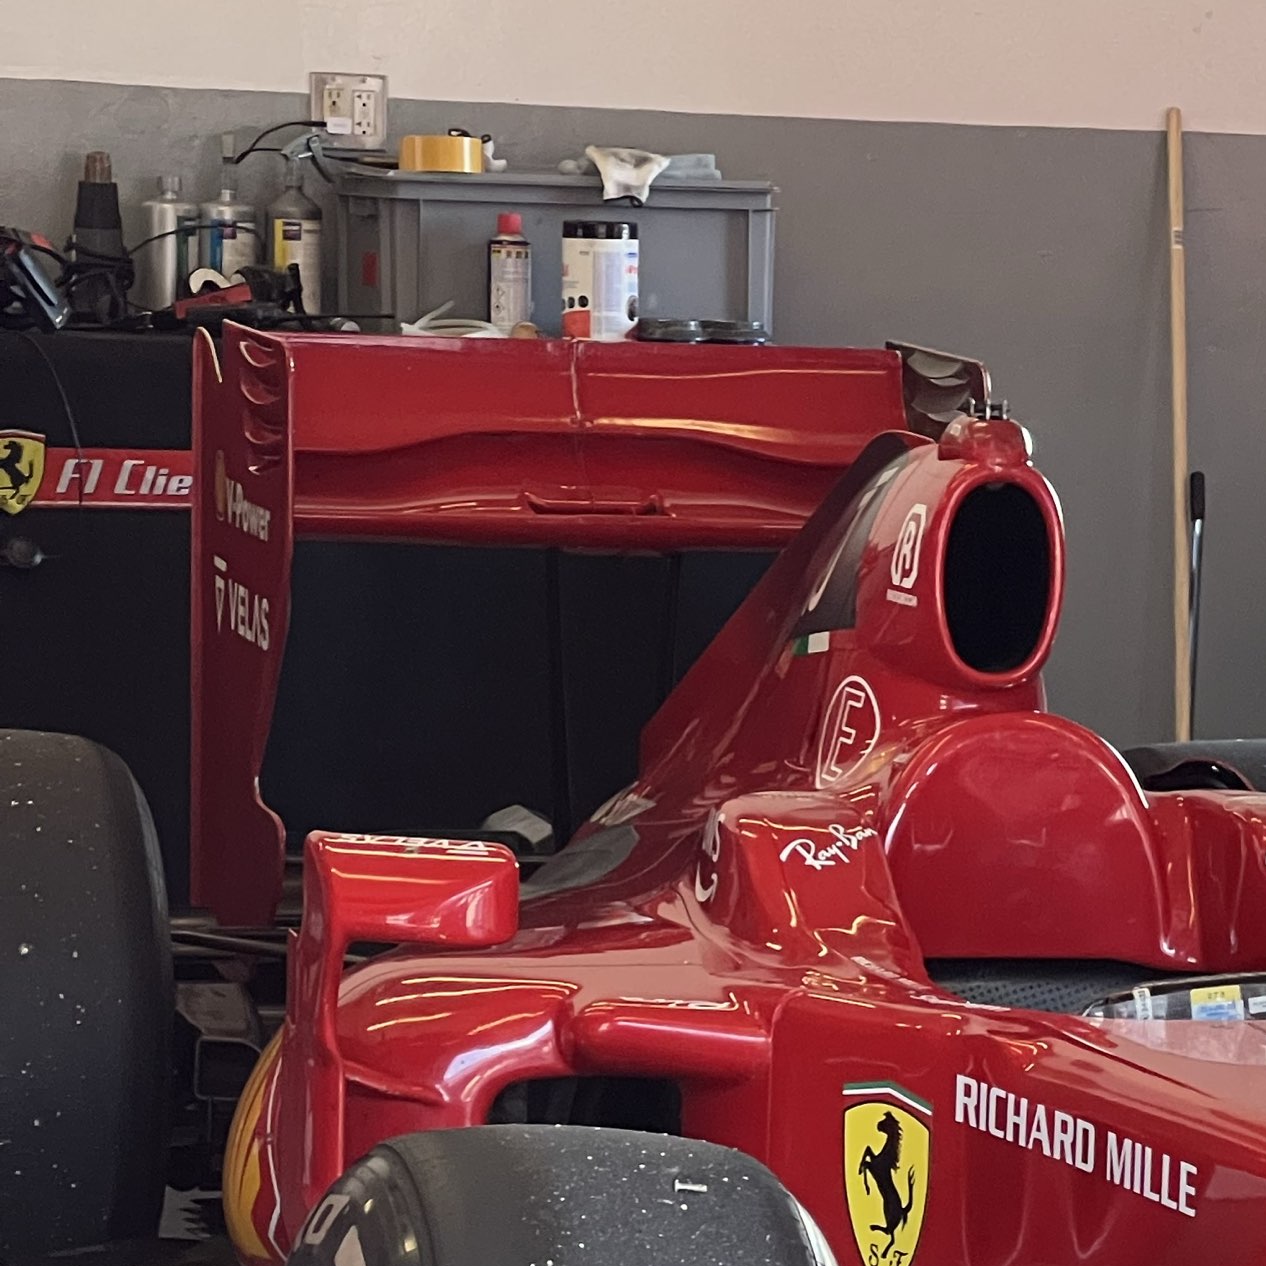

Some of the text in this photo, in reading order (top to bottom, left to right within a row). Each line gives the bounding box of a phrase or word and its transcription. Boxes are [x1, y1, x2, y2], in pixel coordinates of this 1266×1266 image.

[56, 458, 194, 495] F1 Clie
[226, 476, 272, 543] V-Power
[227, 578, 270, 651] VELAS
[954, 1073, 1198, 1218] RICHARD MILLE
